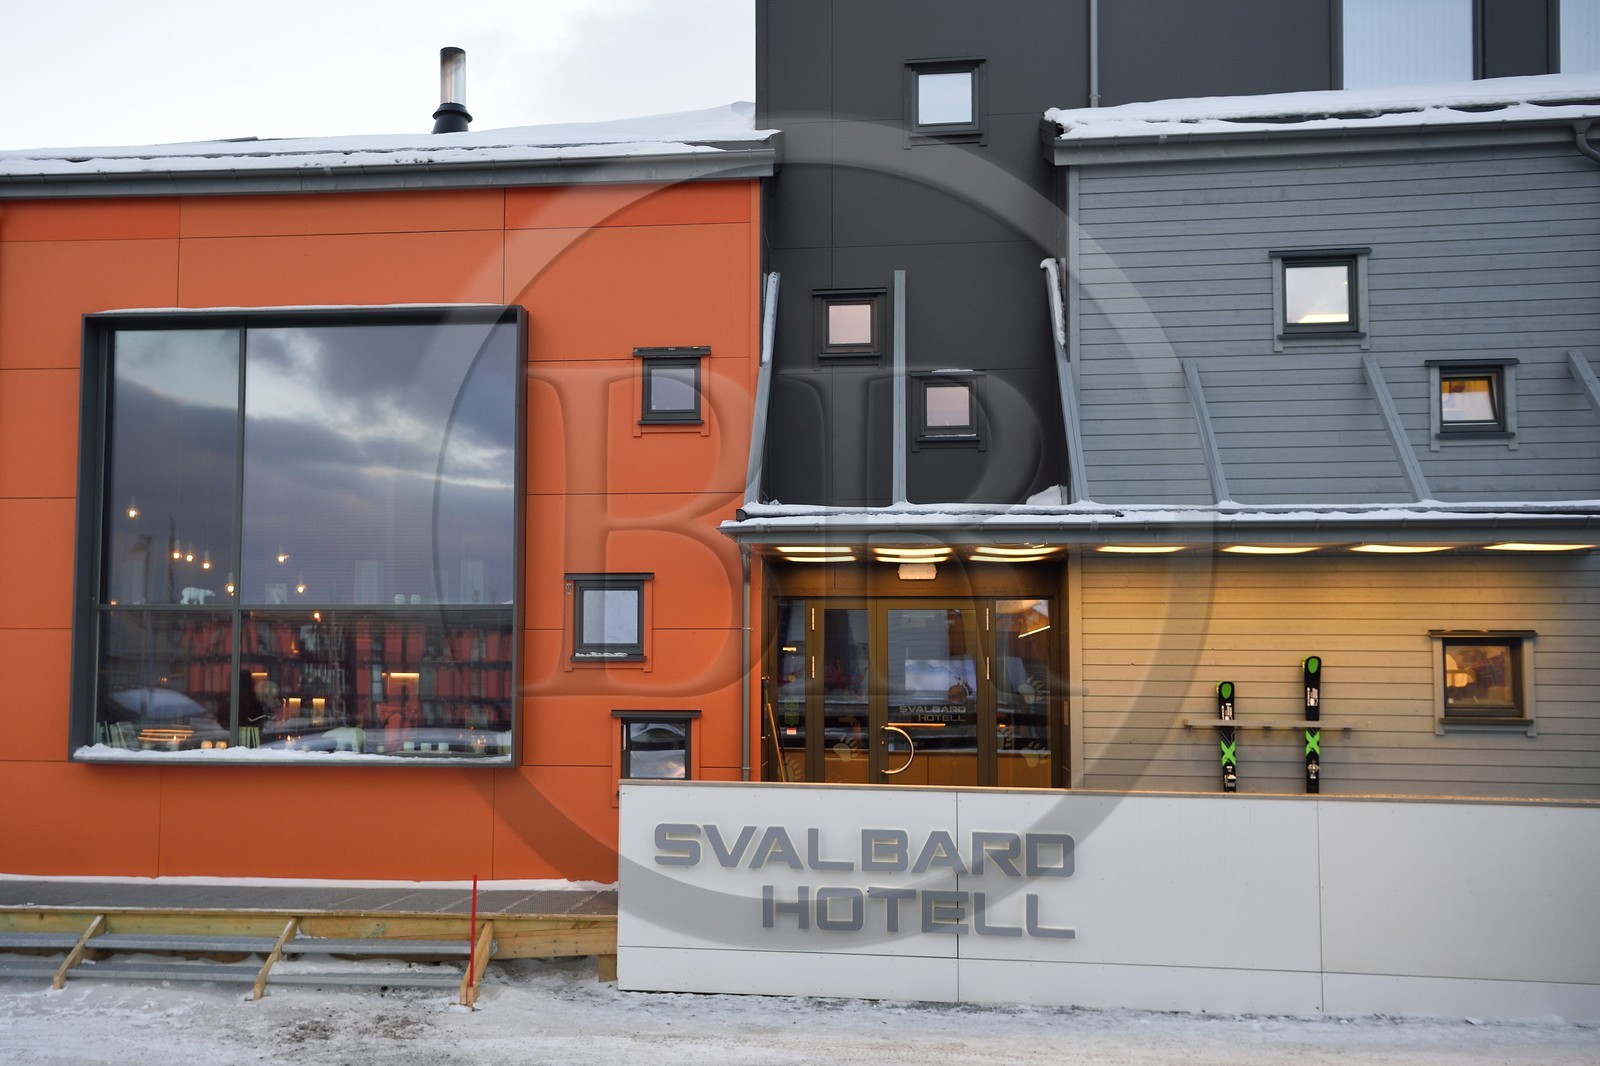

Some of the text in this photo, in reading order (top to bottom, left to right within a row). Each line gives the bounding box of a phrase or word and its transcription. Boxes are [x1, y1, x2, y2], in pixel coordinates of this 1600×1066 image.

[899, 705, 966, 713] SVALBARD
[654, 823, 1075, 877] SVALBARD
[762, 885, 1076, 939] HOTELL
